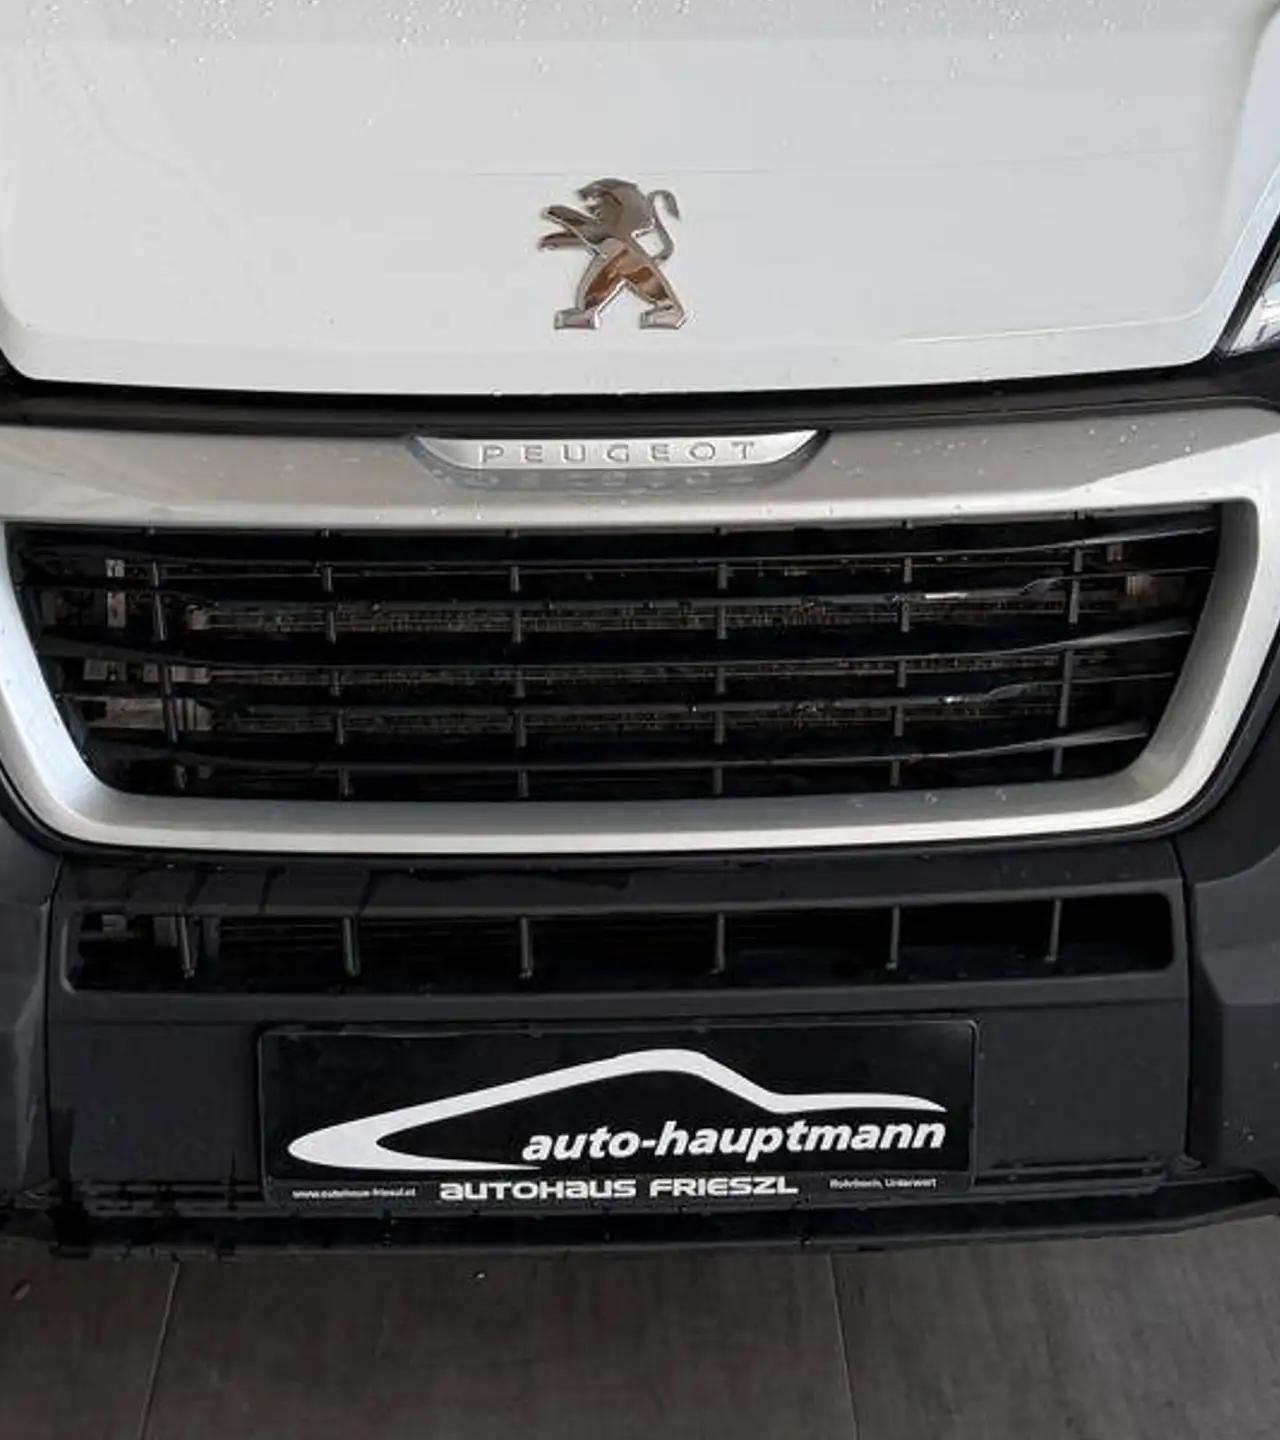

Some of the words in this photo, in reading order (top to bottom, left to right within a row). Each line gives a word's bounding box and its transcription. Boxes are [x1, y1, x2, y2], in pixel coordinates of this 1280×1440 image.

[479, 441, 755, 463] PEUGEOT
[522, 1120, 948, 1163] auto-hauptmann
[648, 1175, 800, 1198] FRIESZL
